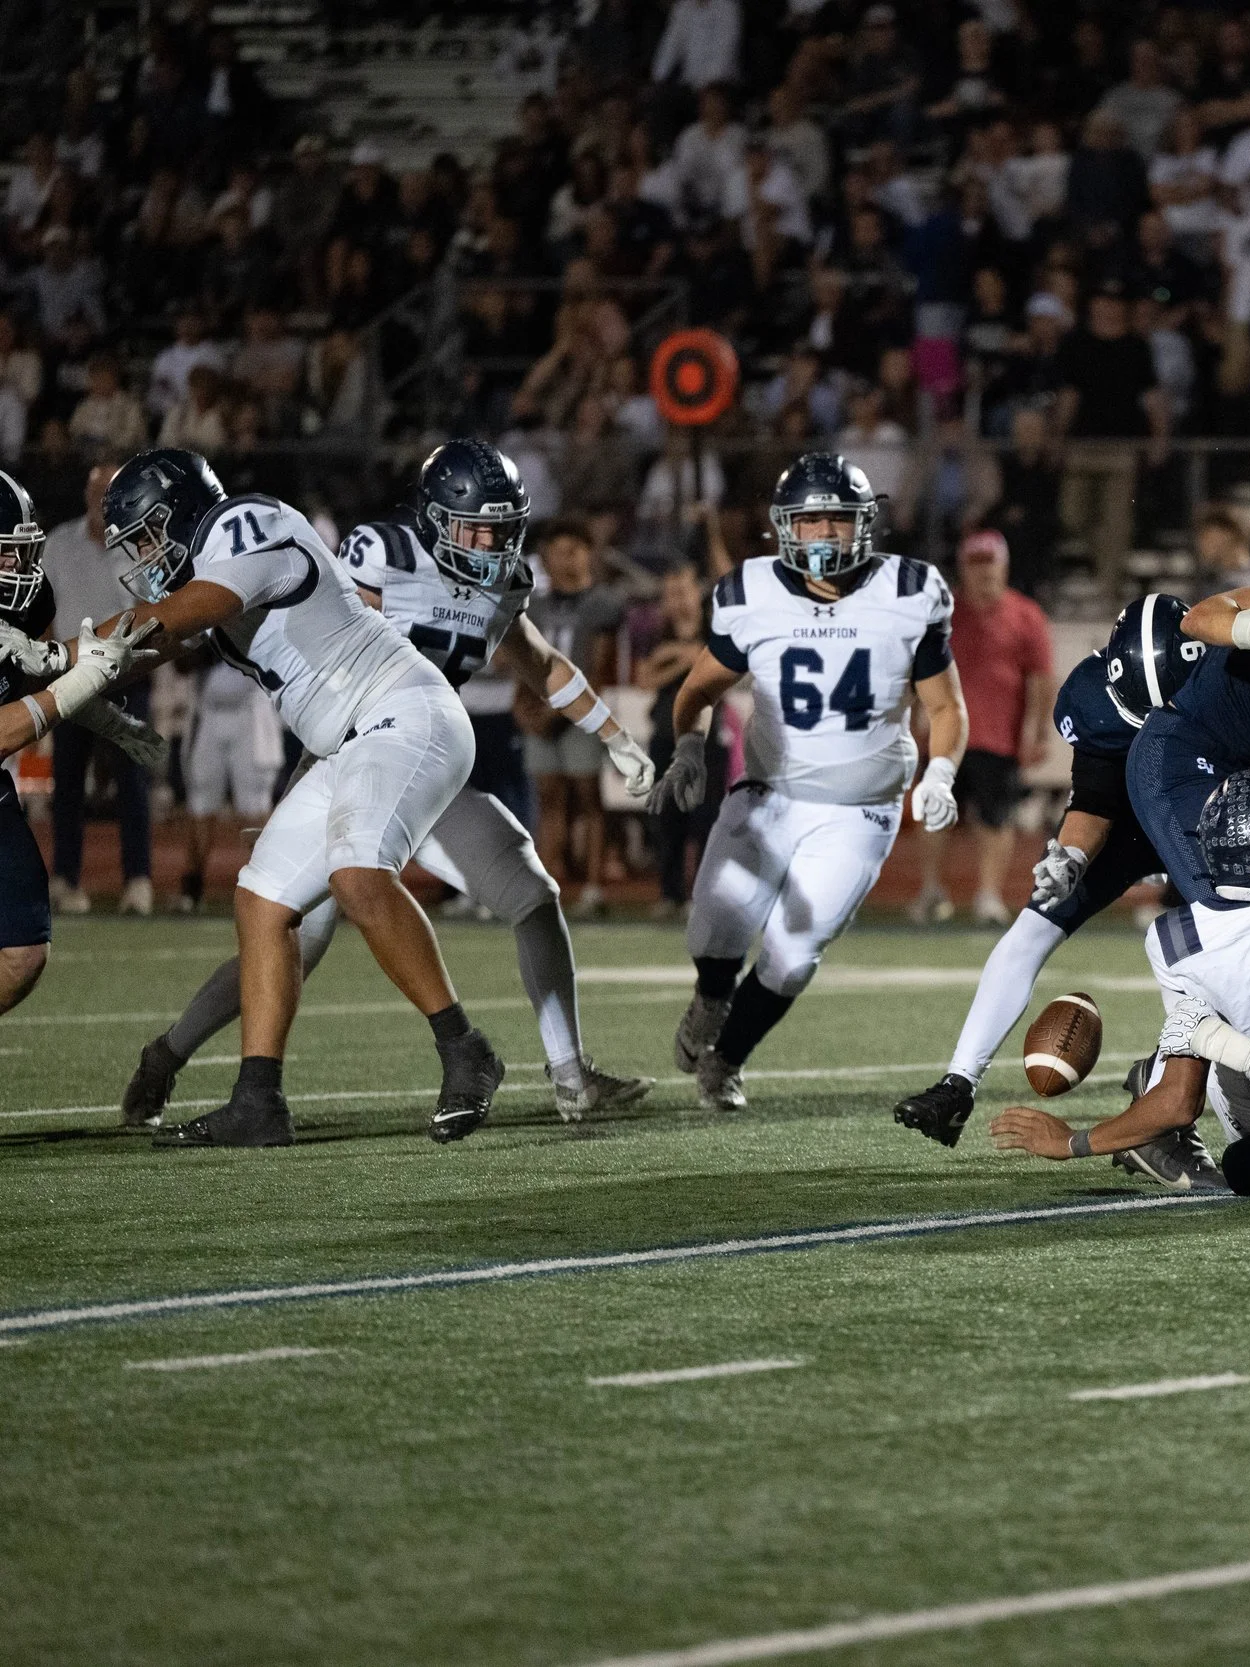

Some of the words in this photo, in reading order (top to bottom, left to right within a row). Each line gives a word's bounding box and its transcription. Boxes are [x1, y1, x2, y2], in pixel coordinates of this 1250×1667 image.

[221, 510, 269, 557] 71
[432, 606, 485, 628] CHAMPION
[792, 627, 858, 639] CHAMPION
[779, 646, 876, 732] 64
